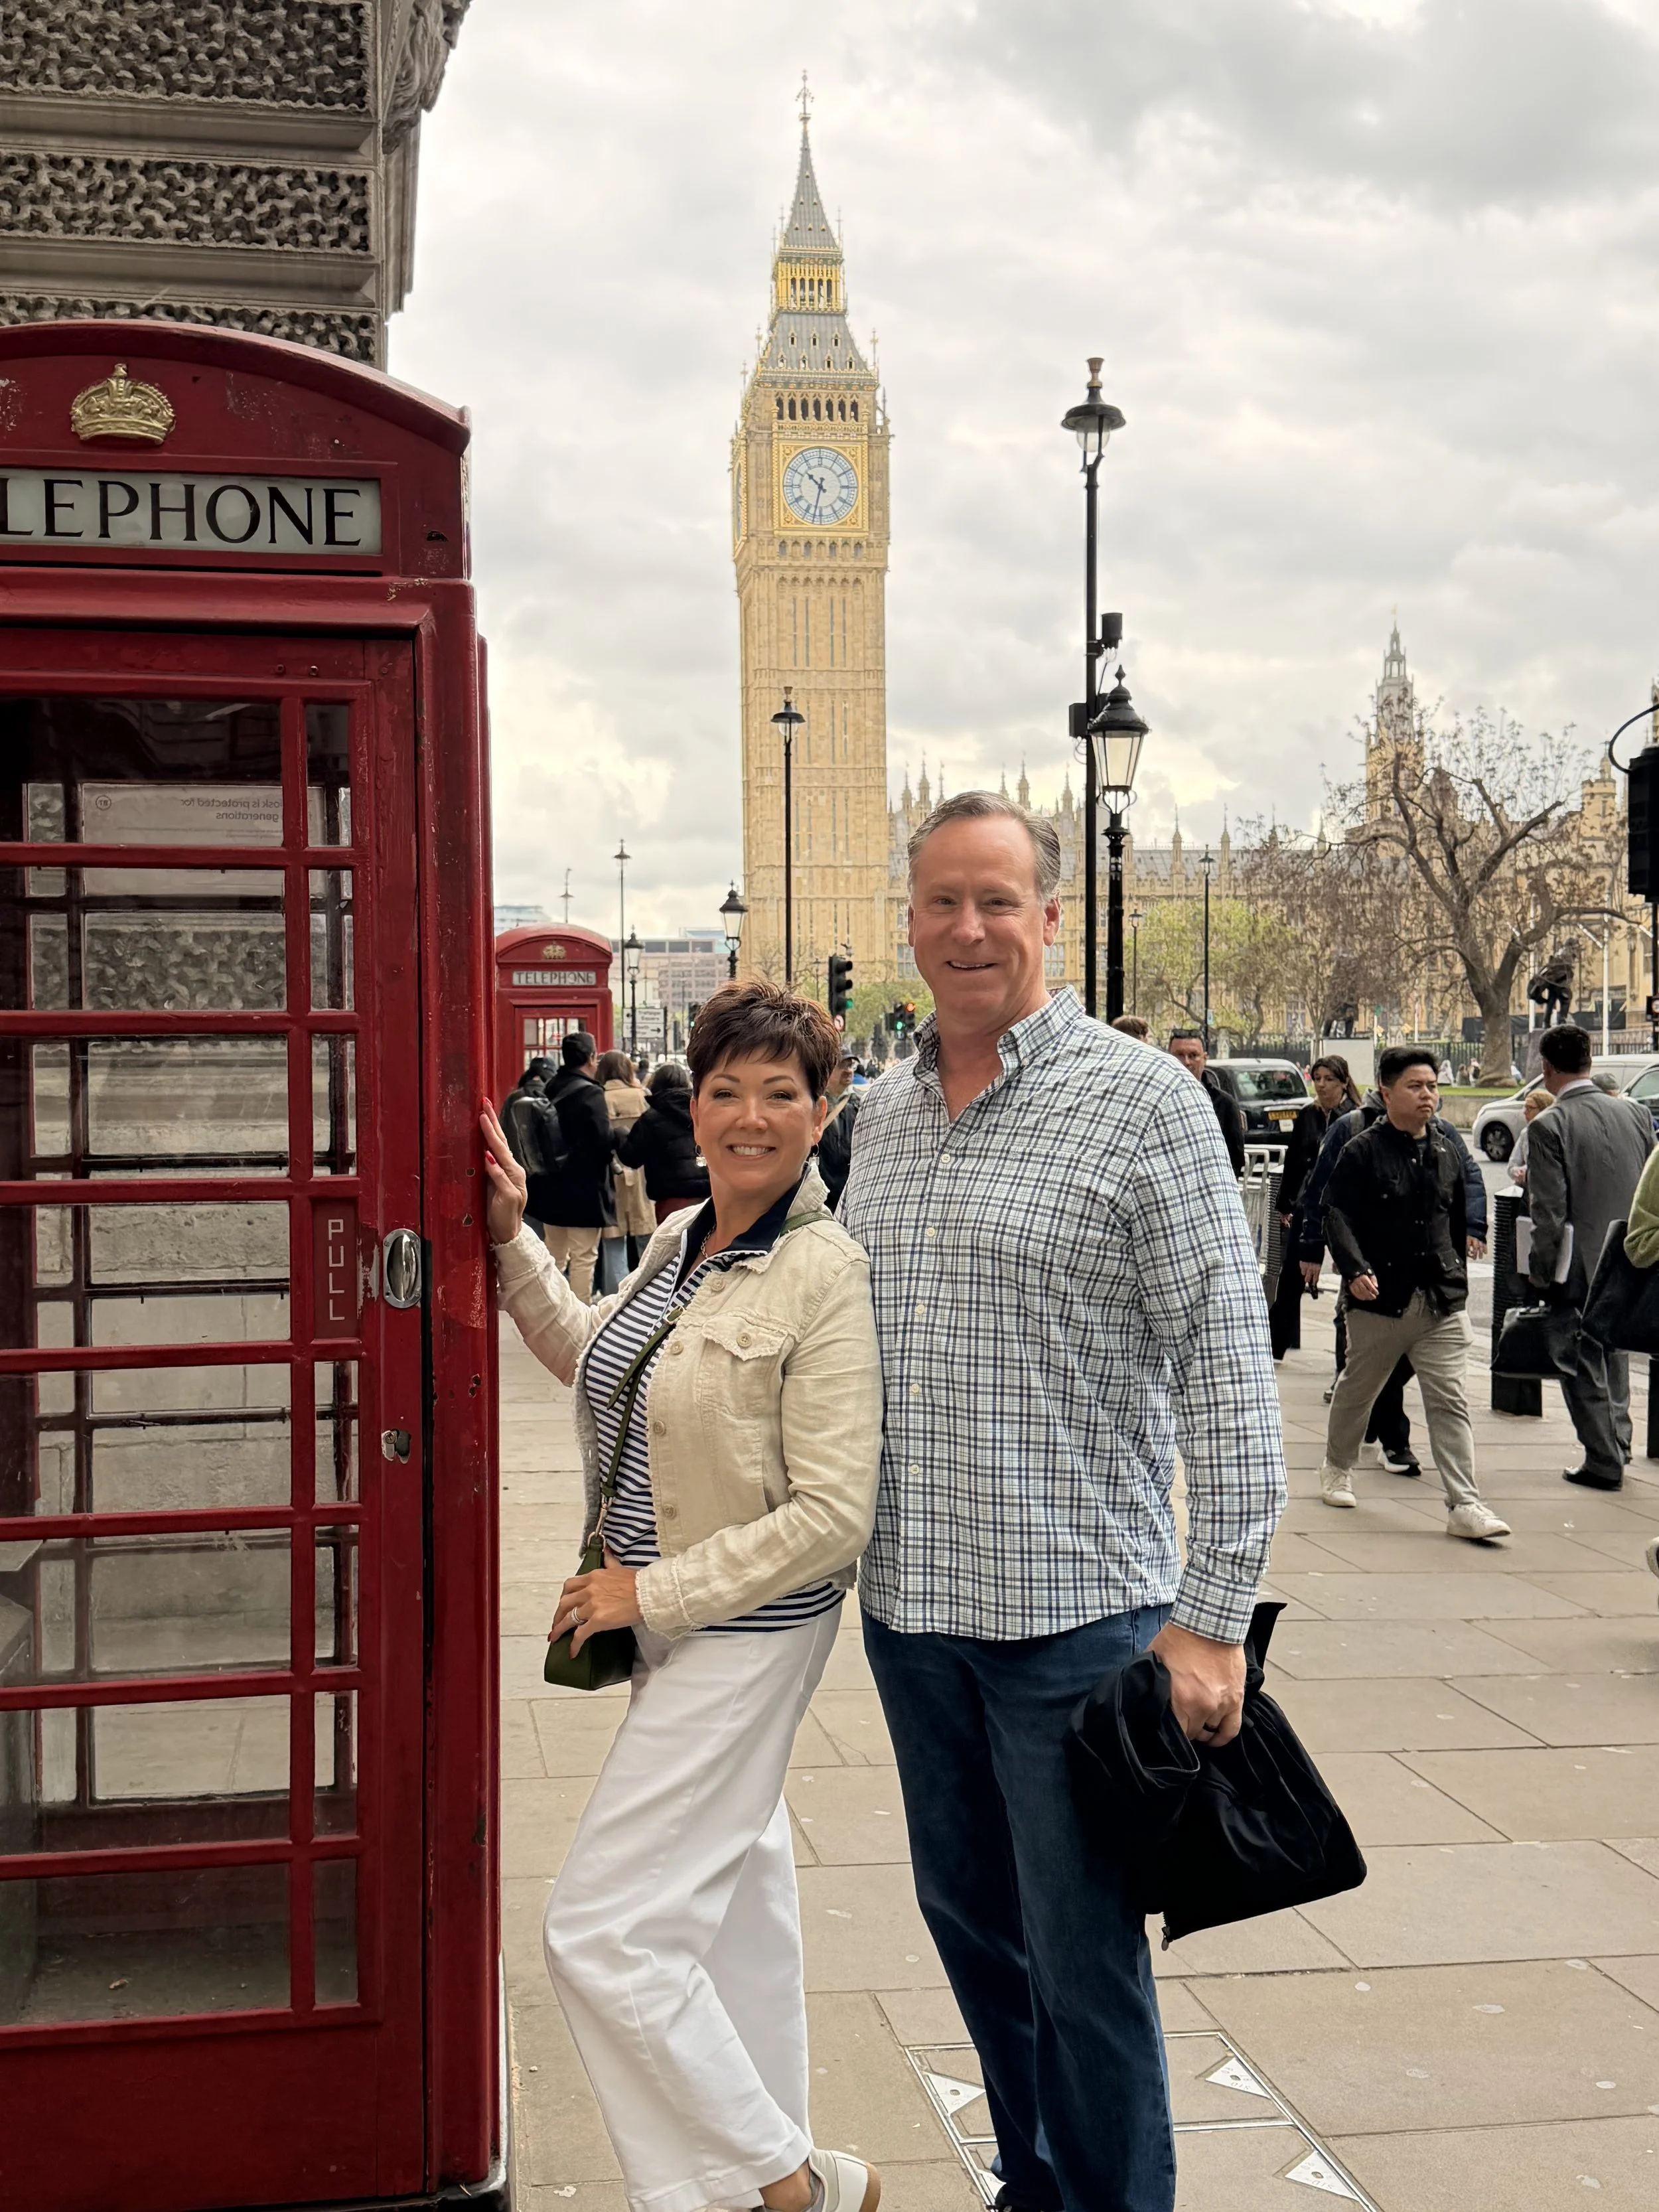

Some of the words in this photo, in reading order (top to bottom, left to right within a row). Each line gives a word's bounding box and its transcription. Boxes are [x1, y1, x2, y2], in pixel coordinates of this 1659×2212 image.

[0, 478, 360, 546] LEPHONE
[516, 971, 594, 985] TELEPHONE
[328, 1218, 345, 1321] PULL
